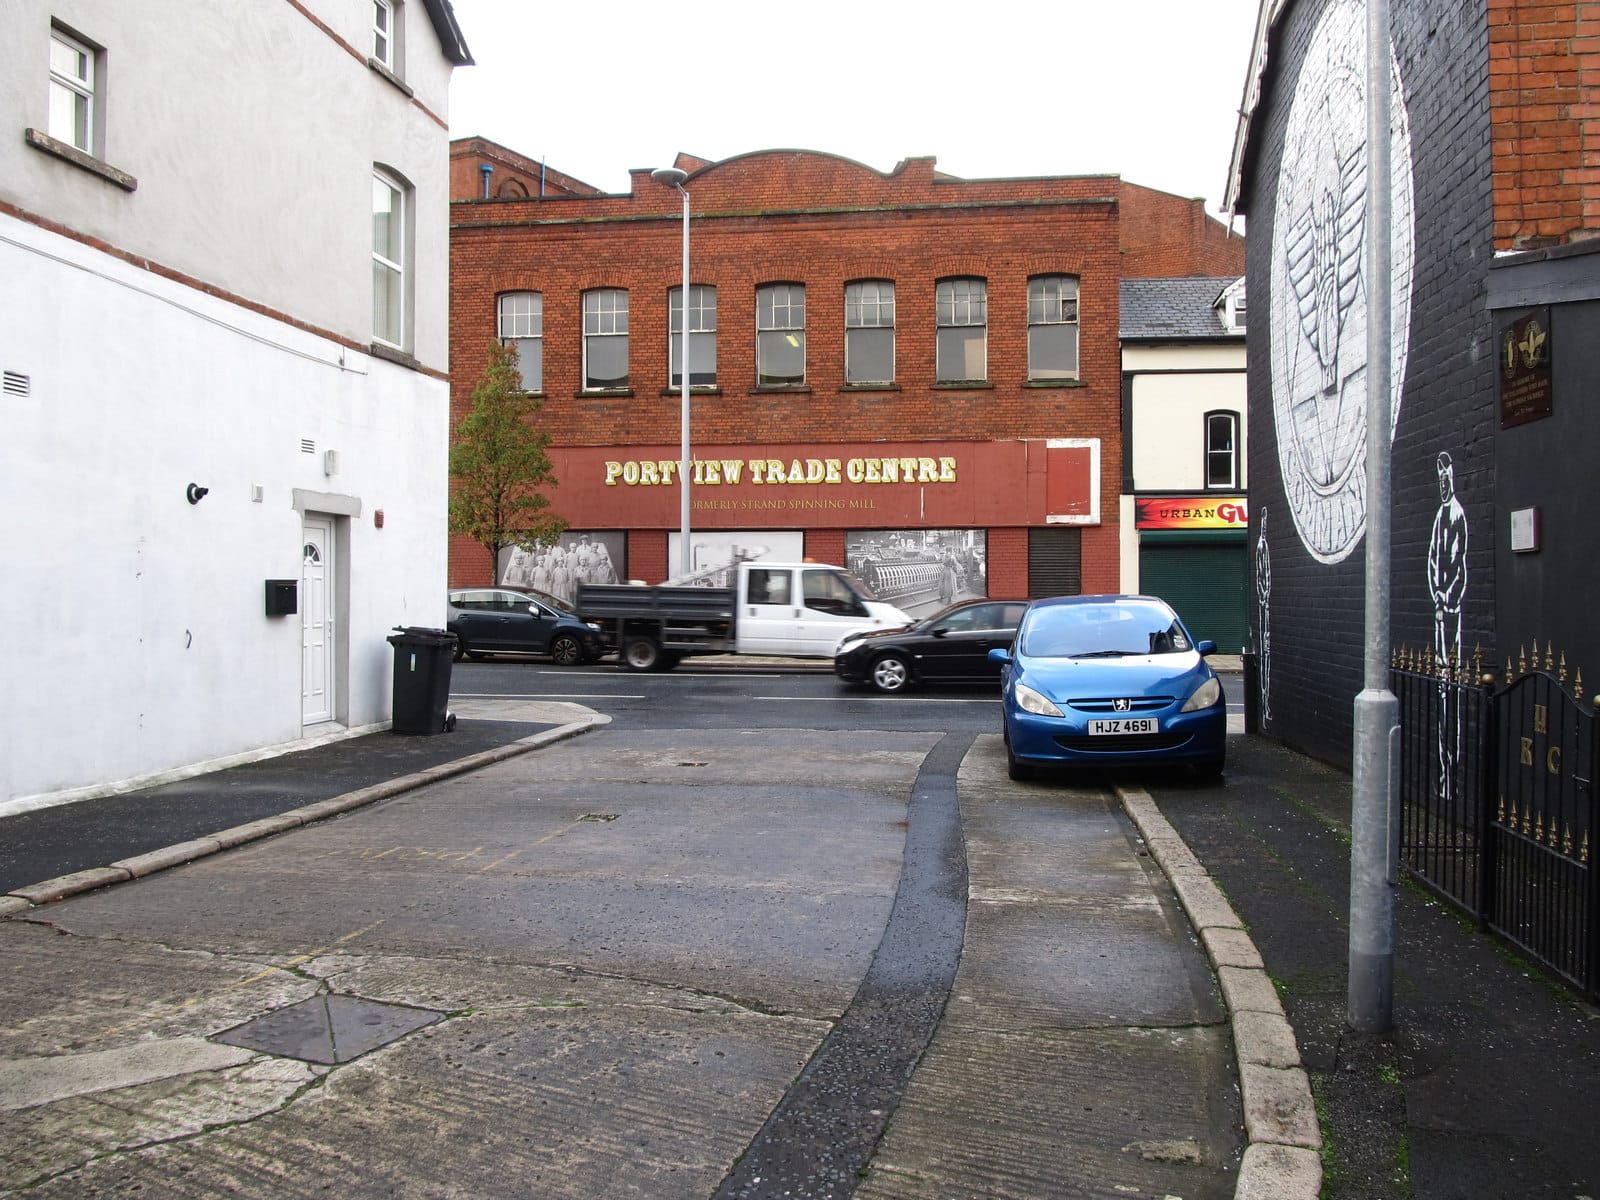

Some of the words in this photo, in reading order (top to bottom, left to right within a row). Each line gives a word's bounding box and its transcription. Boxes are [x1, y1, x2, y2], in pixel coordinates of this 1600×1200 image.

[605, 460, 744, 486] PORTVIEW
[749, 458, 841, 485] TRADE
[847, 457, 957, 483] CENTRE
[690, 499, 738, 510] ORMERLY
[741, 499, 786, 510] STRAND
[789, 499, 846, 509] SPINNING
[849, 499, 876, 509] MILL
[1160, 509, 1214, 518] URBAN
[1096, 721, 1120, 733] HJZ
[1124, 720, 1151, 732] 4691
